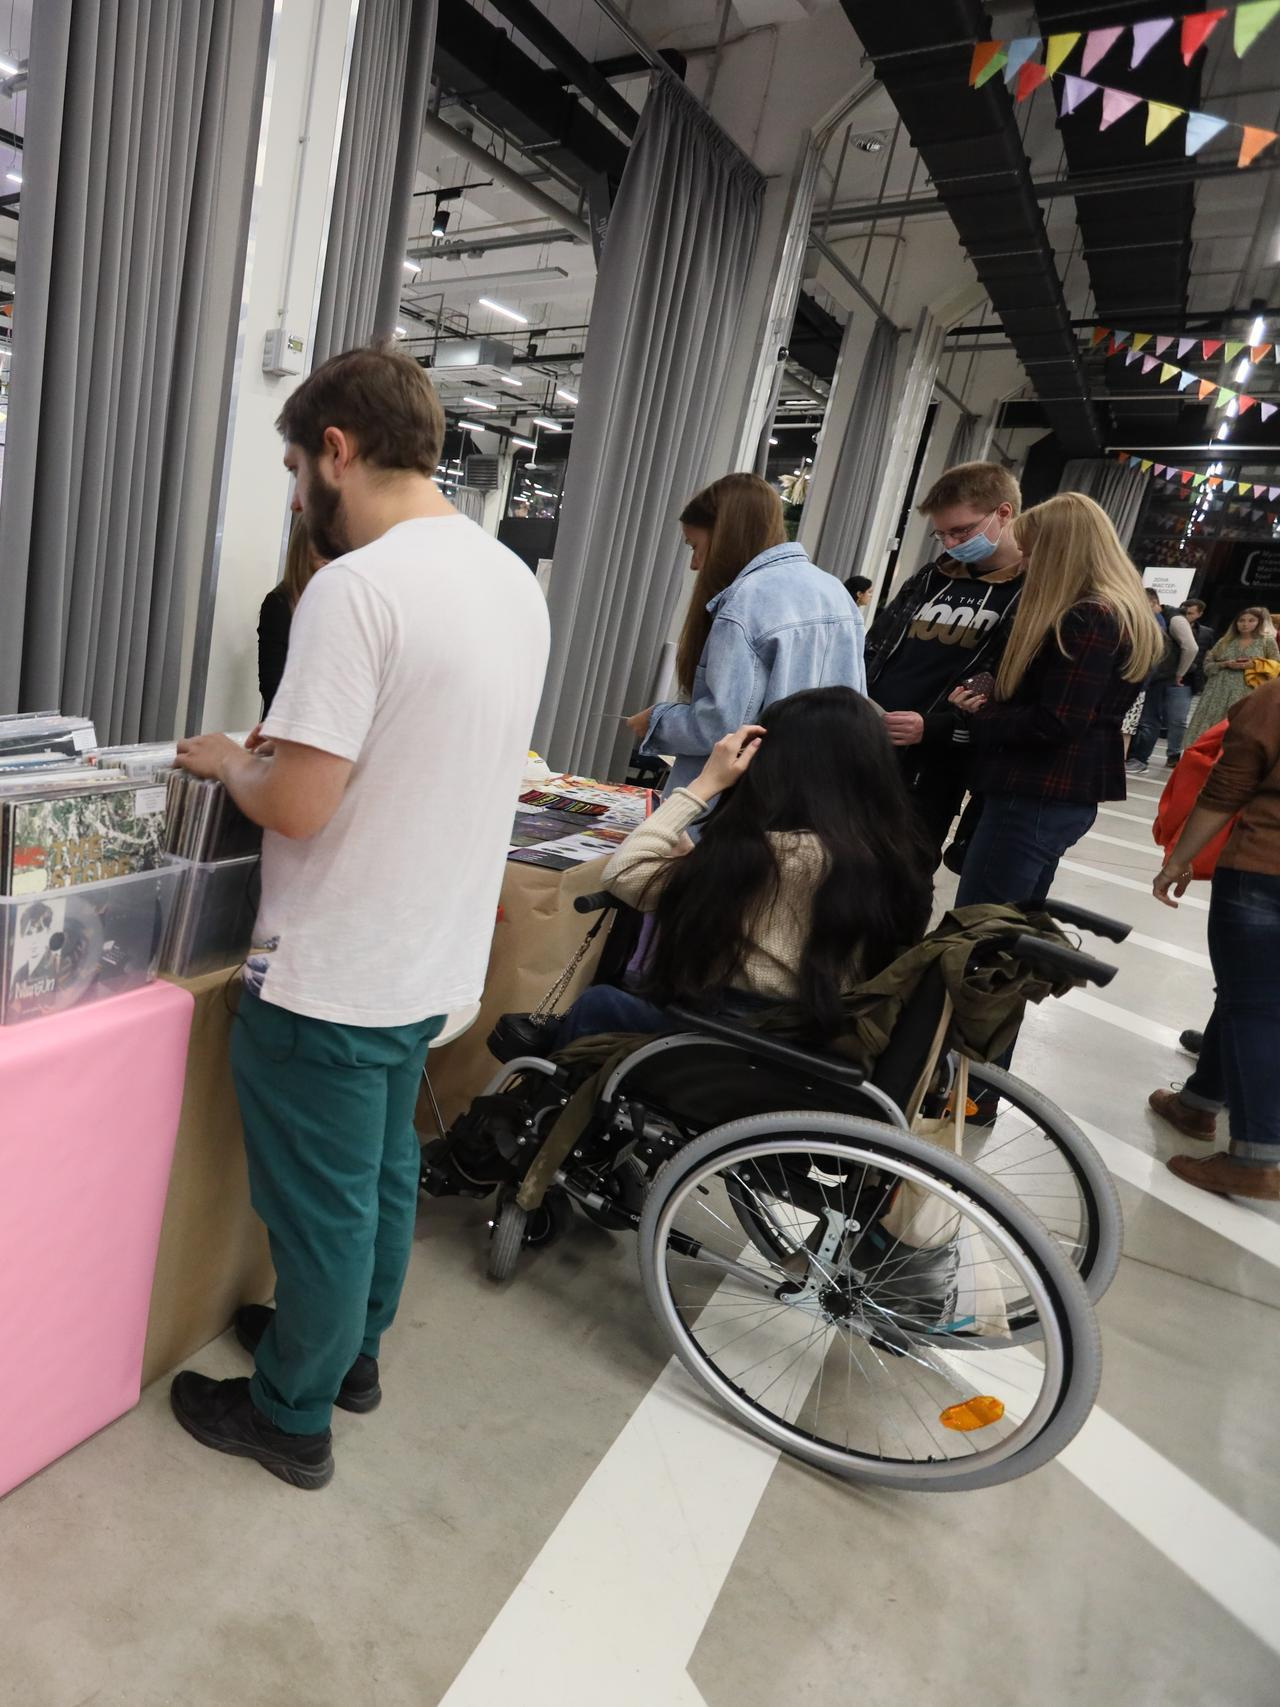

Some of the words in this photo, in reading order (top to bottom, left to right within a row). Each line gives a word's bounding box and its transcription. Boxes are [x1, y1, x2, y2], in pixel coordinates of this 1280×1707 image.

[938, 593, 953, 602] IN
[959, 596, 986, 606] THE
[51, 833, 103, 866] THE
